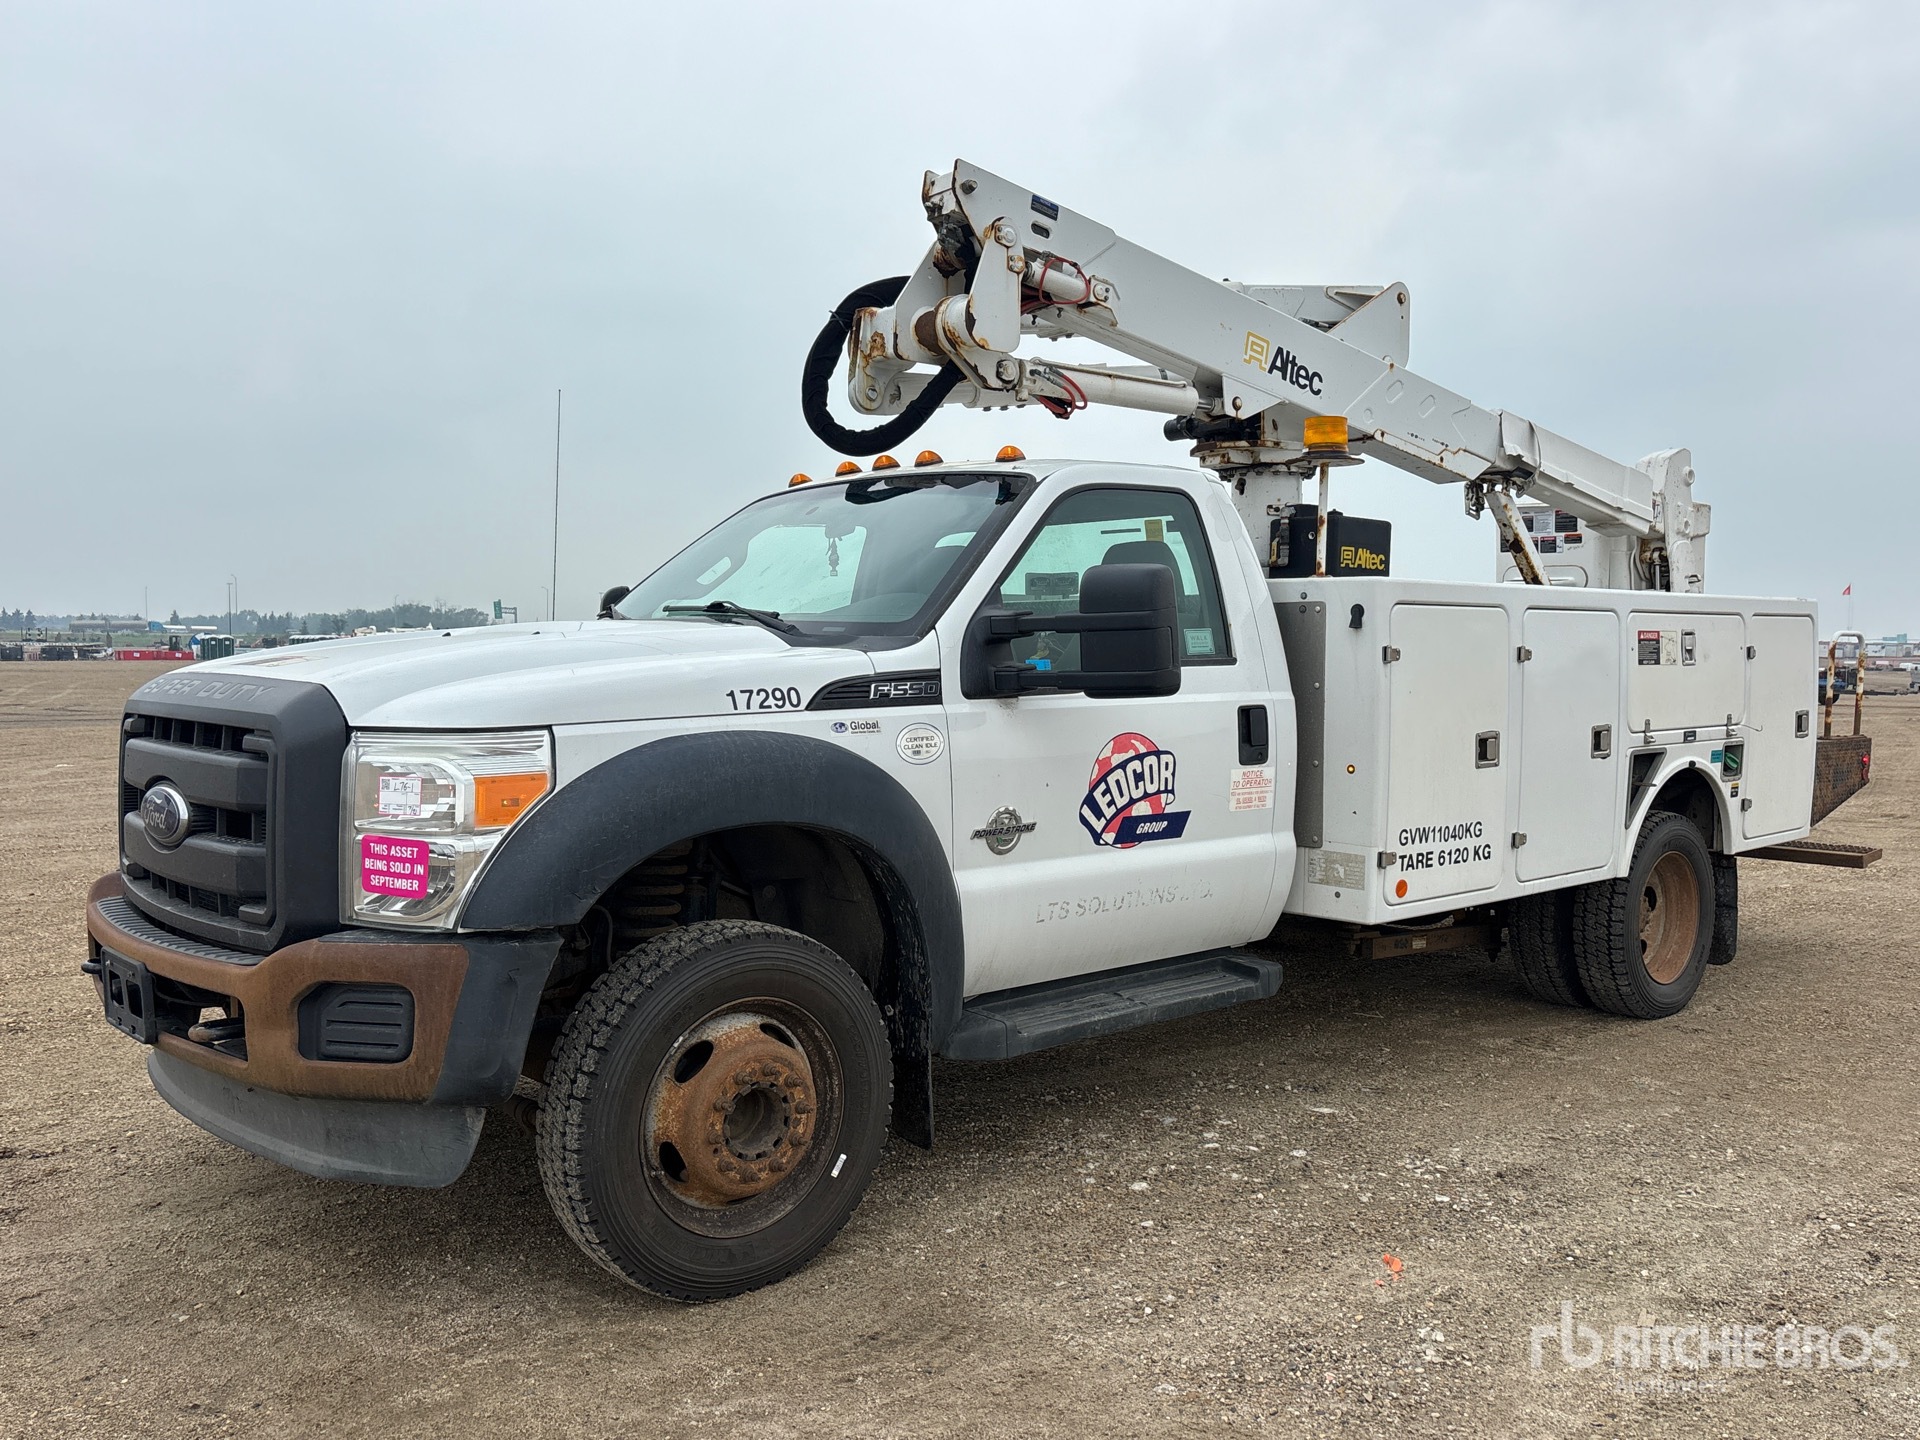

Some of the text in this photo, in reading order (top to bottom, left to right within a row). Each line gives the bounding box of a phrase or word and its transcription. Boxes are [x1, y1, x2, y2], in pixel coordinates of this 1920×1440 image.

[1267, 346, 1323, 396] Altec
[1354, 548, 1386, 570] Altec
[196, 681, 275, 701] DUTY
[725, 686, 802, 711] 17290
[869, 681, 940, 699] F-550
[1241, 779, 1272, 788] OPERATOR
[1242, 770, 1264, 778] NOTICE
[1081, 754, 1174, 834] LEDCOR
[144, 795, 167, 829] Ford
[1136, 821, 1168, 834] GROUP
[1398, 821, 1483, 847] GVW11040KG
[369, 843, 419, 859] THIS ASSET
[1398, 843, 1492, 872] TARE 6120 KG
[364, 858, 424, 876] BEING SOLD IN
[370, 874, 420, 891] SEPTEMBER
